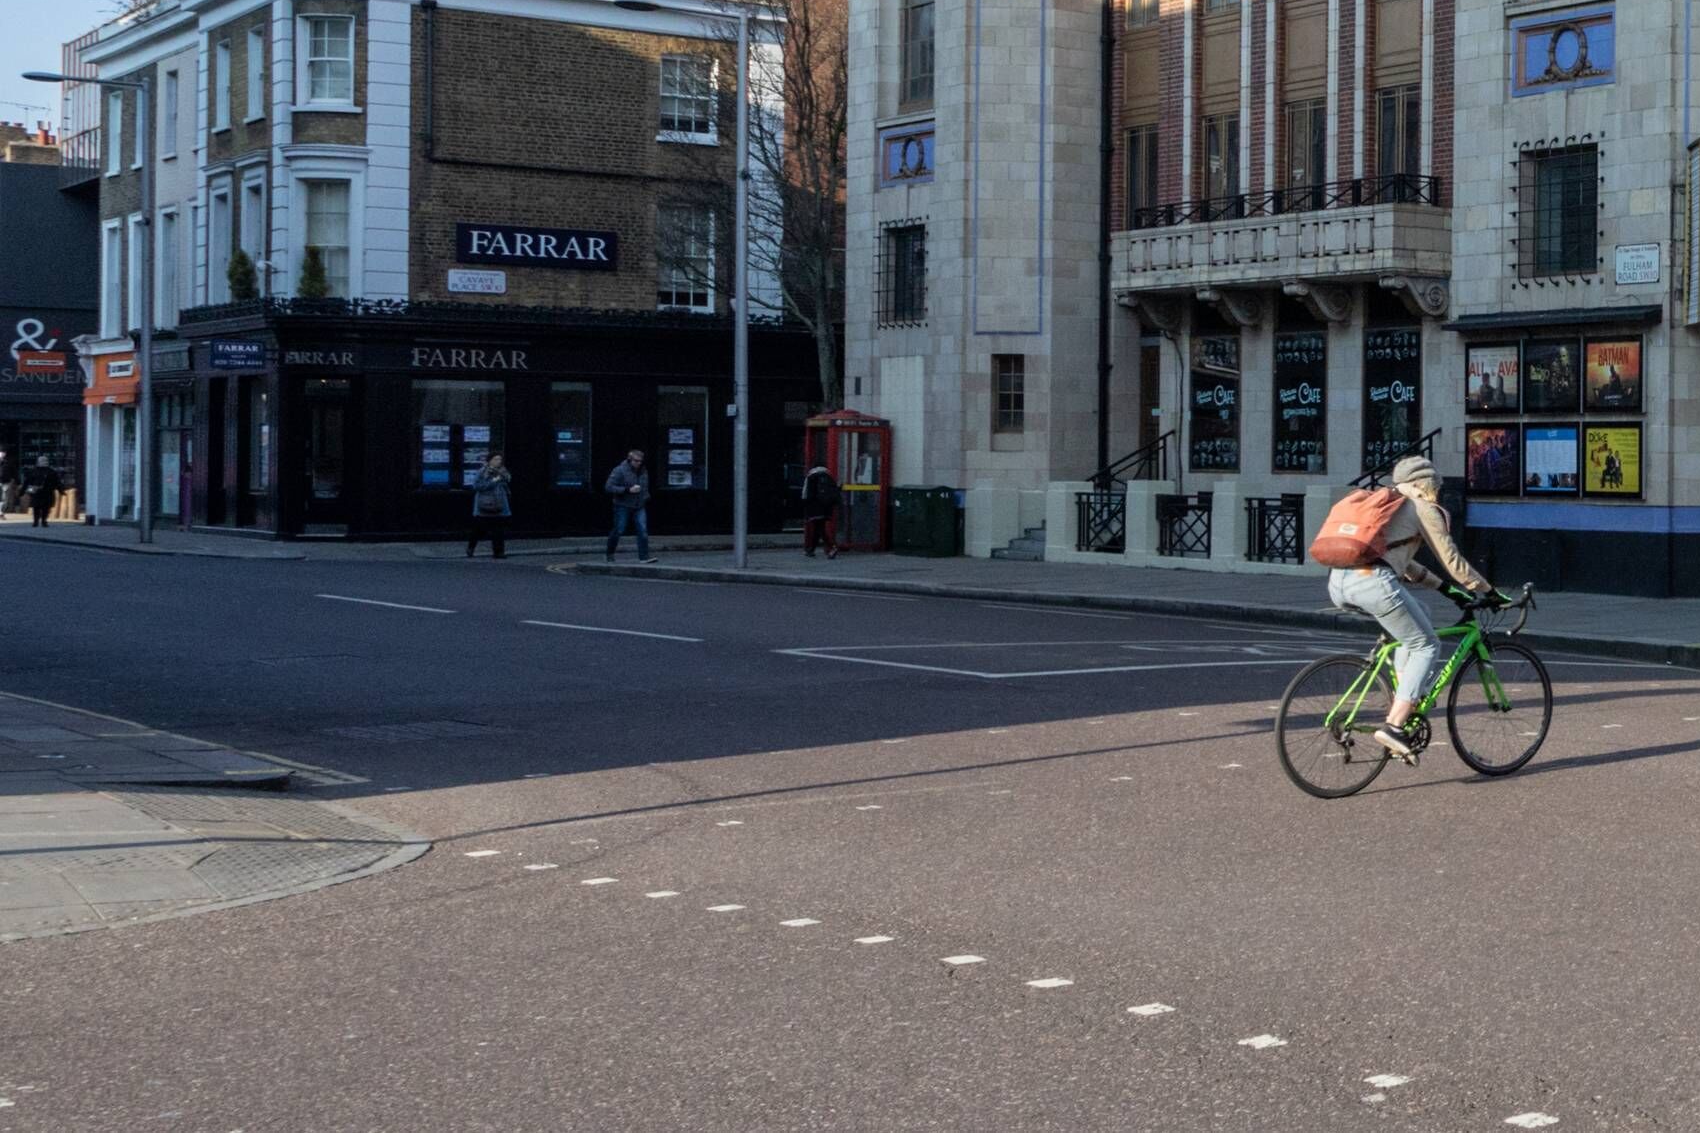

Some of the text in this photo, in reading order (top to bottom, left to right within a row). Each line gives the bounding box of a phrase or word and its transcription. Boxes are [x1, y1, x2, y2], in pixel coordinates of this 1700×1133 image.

[469, 230, 609, 261] FARRAR
[218, 344, 259, 352] FARRAR
[411, 347, 528, 369] FARRAR
